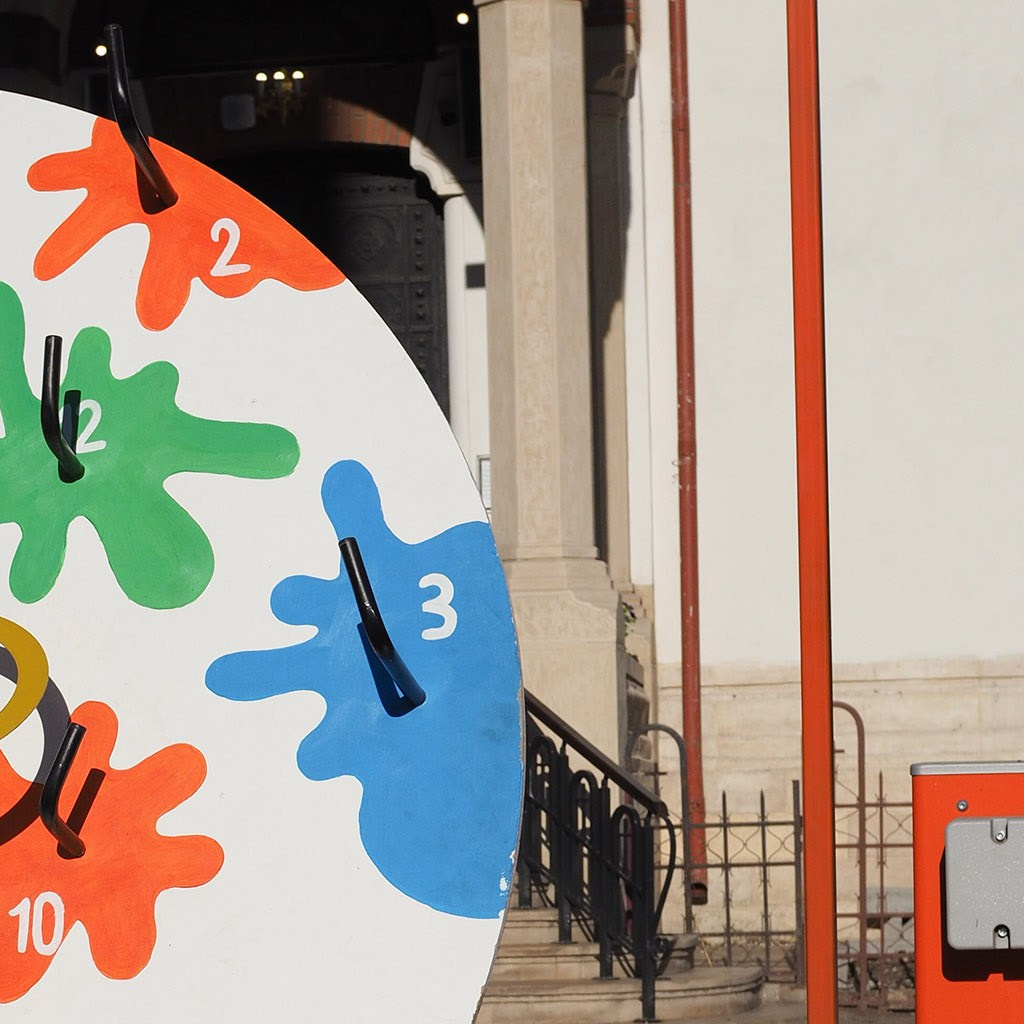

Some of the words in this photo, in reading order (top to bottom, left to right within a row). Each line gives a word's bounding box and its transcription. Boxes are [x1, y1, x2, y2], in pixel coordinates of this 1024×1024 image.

[209, 217, 251, 277] 2
[417, 572, 459, 641] 3
[8, 890, 65, 958] 10
